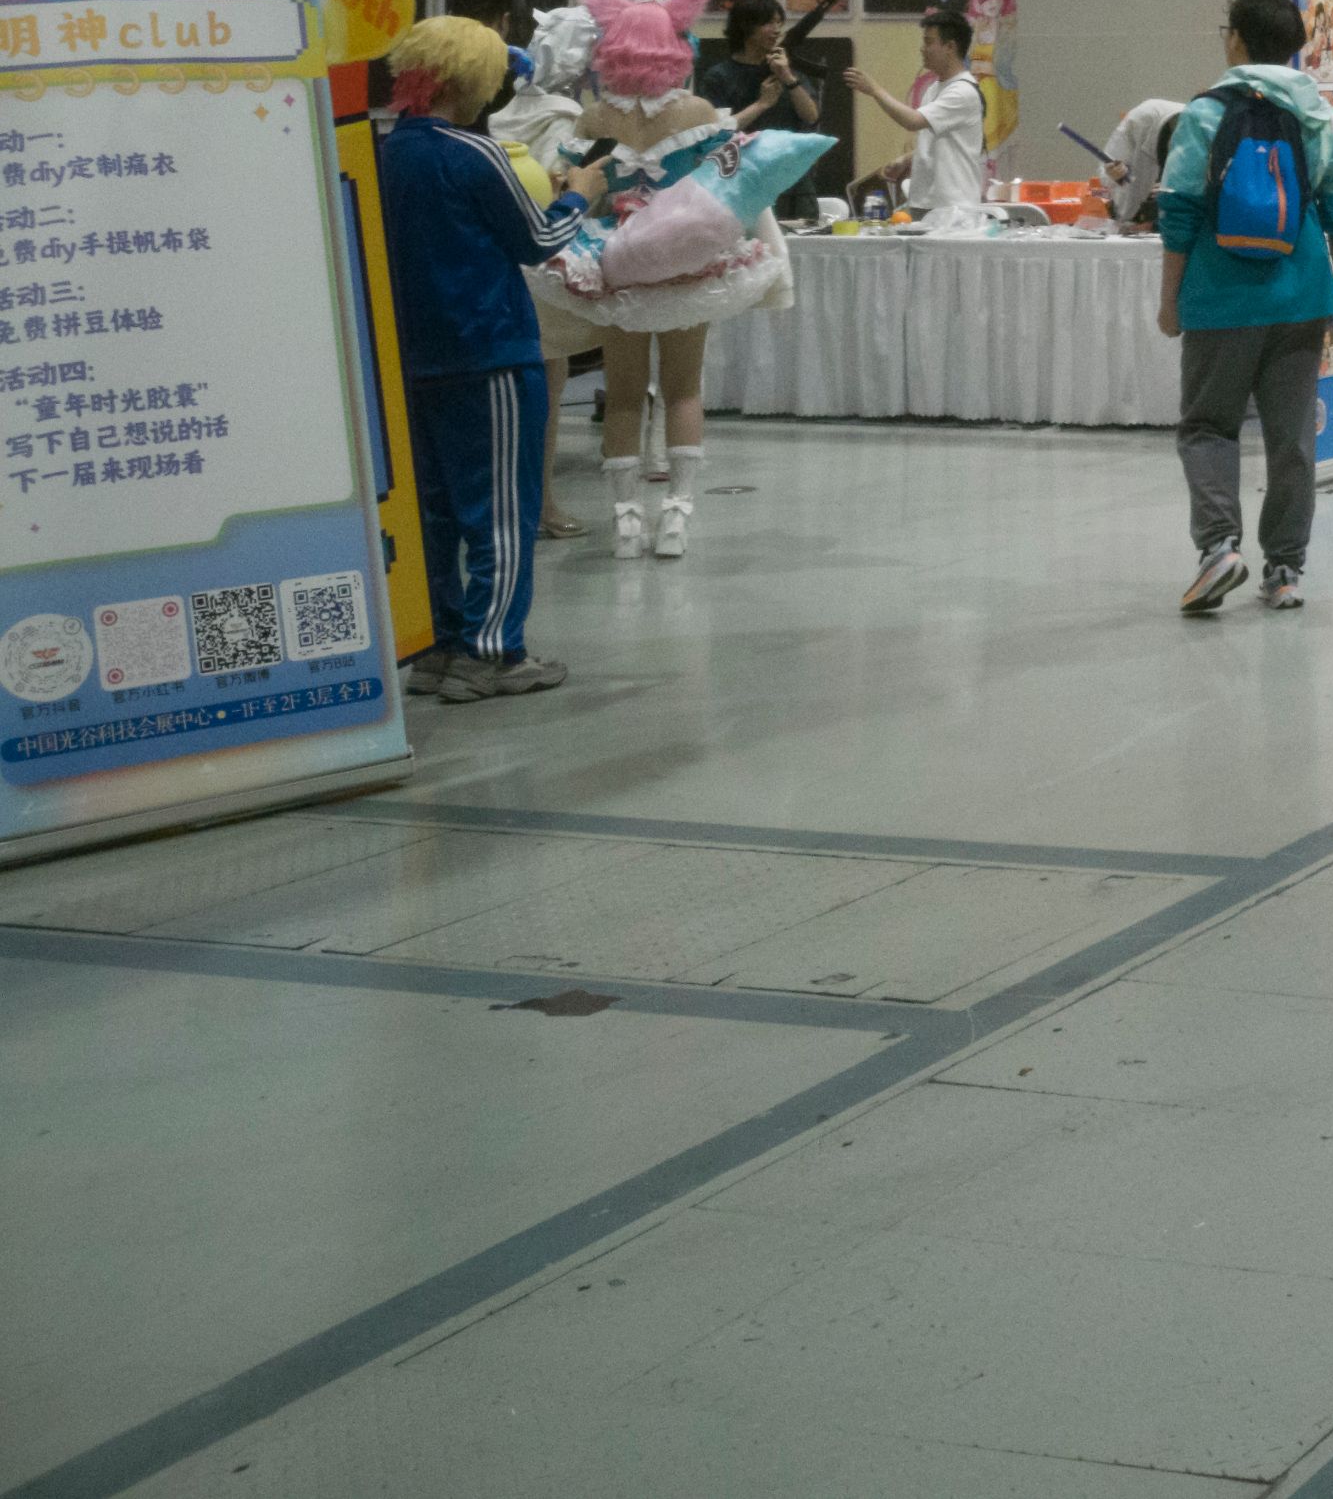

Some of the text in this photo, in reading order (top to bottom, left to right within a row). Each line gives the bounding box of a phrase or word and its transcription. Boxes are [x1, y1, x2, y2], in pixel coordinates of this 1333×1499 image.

[6, 414, 231, 461] 写下自己想说的话
[8, 452, 207, 495] 下一届来现场看
[16, 708, 214, 760] 中国光谷科技会展中心
